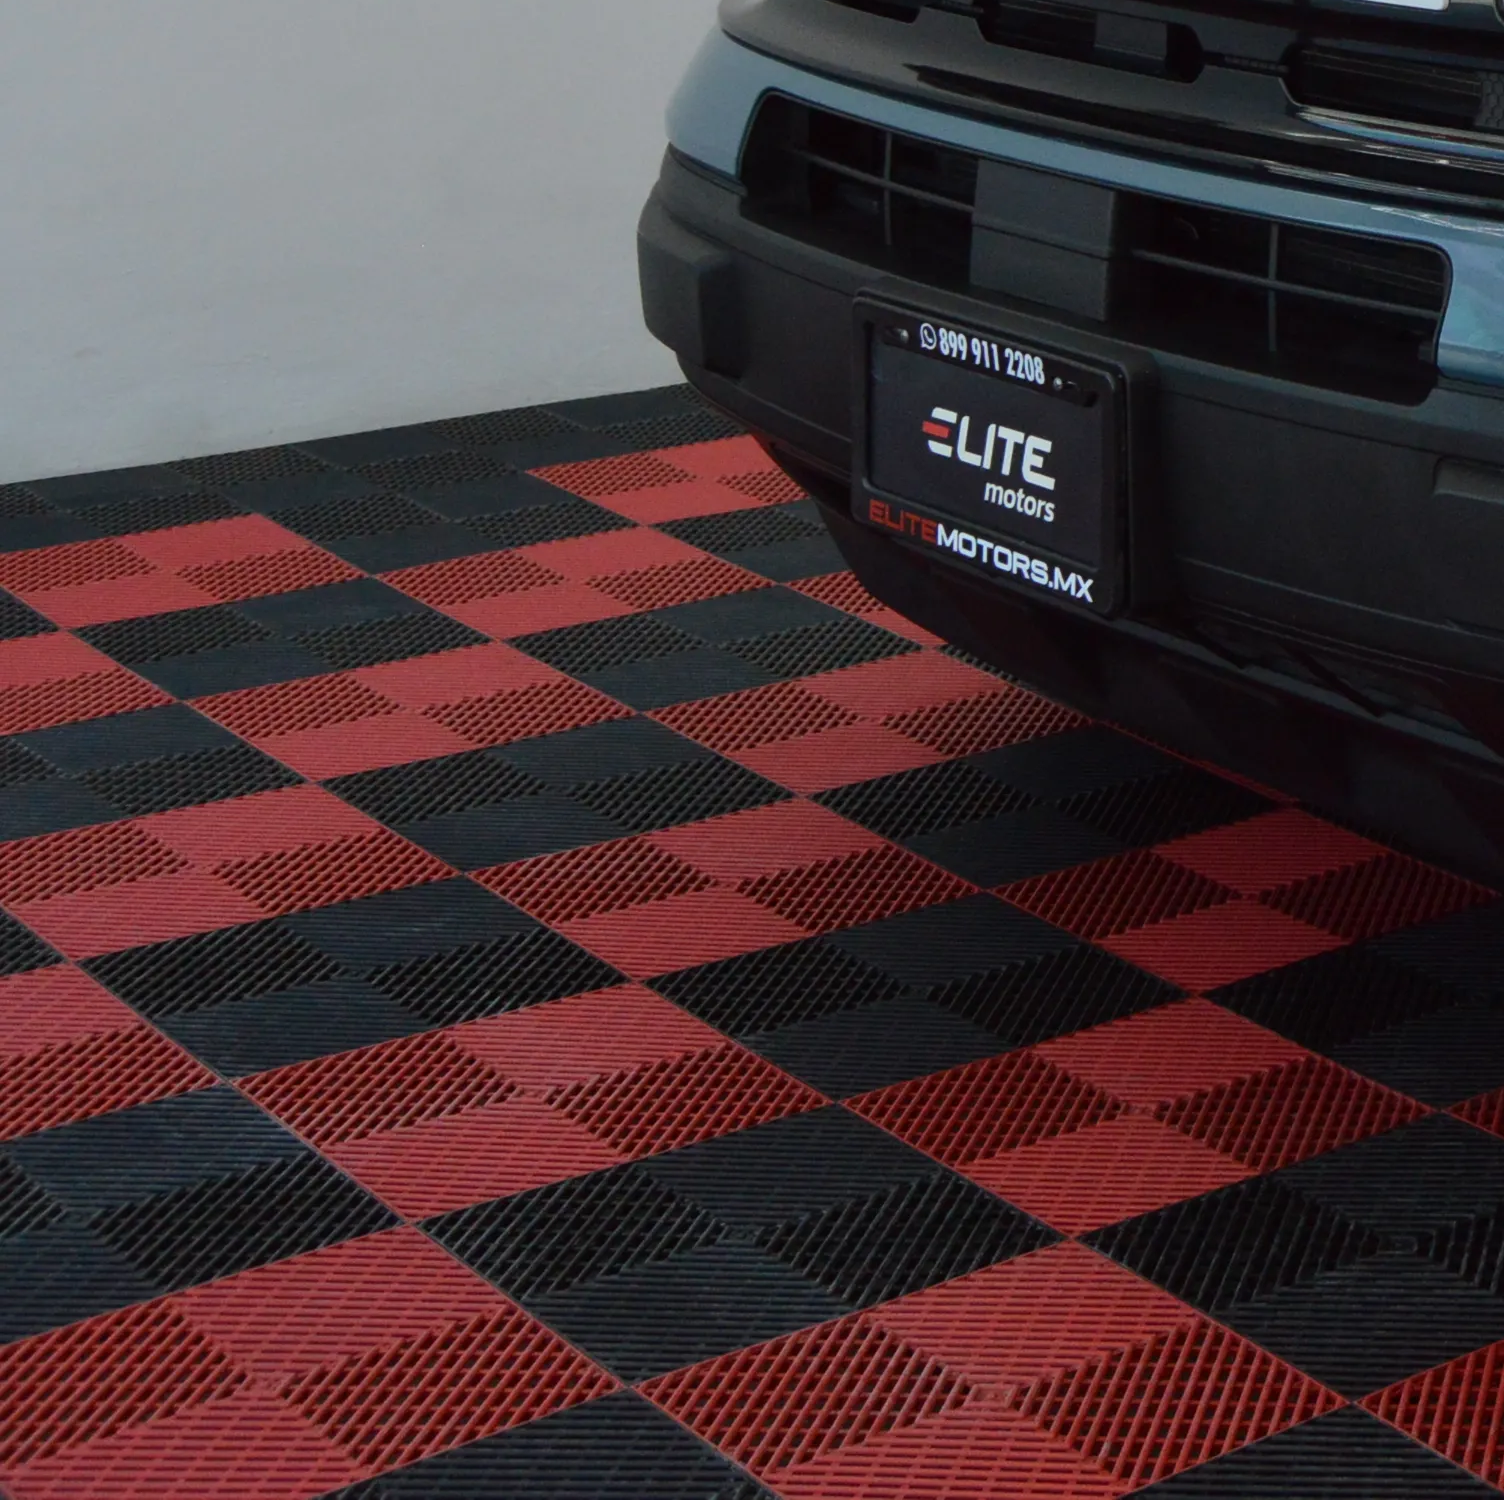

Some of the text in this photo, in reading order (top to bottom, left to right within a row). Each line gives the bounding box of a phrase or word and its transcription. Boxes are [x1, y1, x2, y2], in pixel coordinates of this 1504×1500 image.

[938, 327, 1045, 385] 899 911 2208
[922, 406, 1056, 490] ELITE
[983, 482, 1055, 523] motors
[868, 499, 1094, 603] ELITEMOTORS.MX
